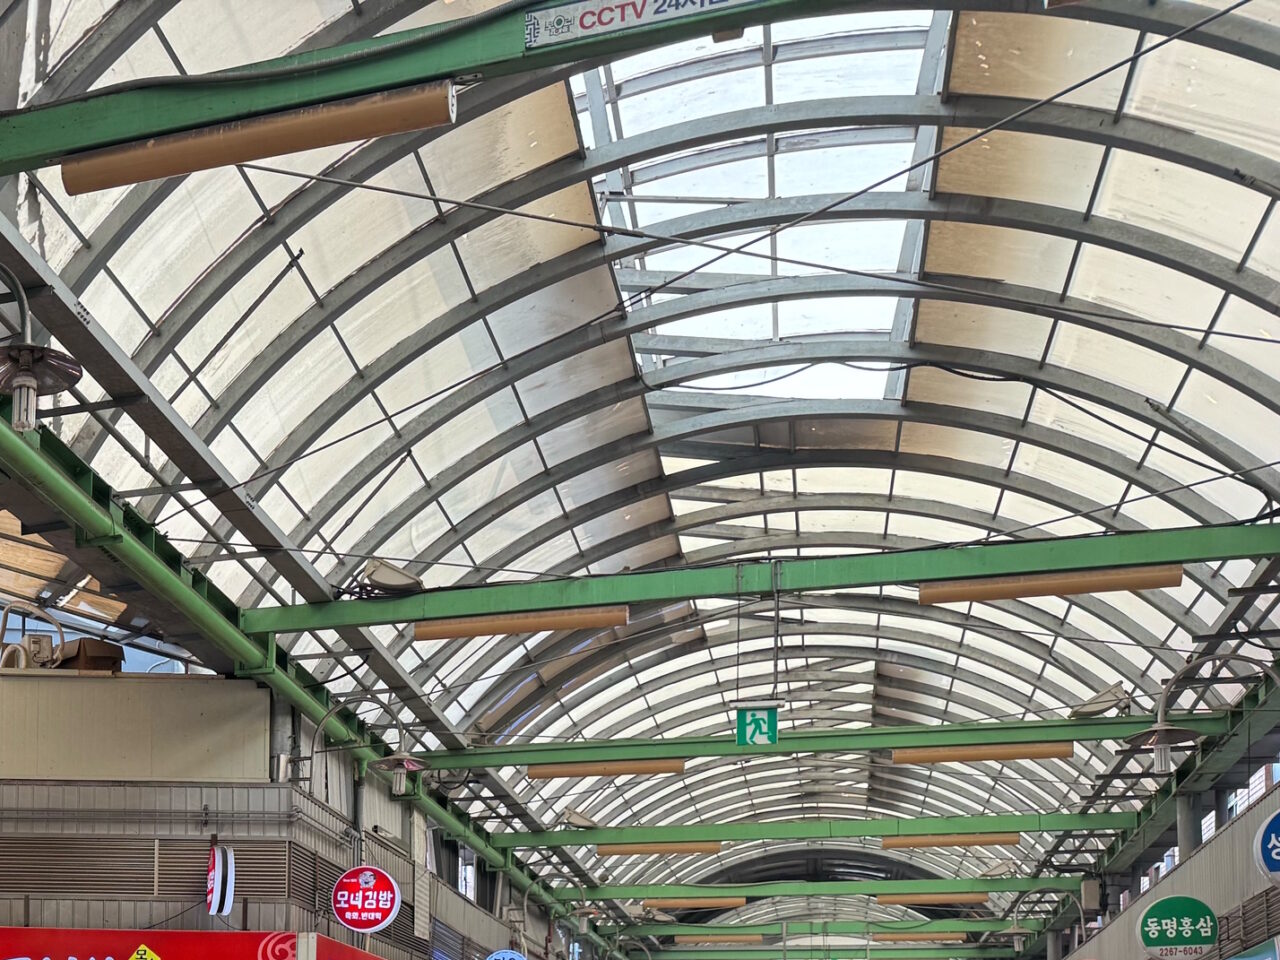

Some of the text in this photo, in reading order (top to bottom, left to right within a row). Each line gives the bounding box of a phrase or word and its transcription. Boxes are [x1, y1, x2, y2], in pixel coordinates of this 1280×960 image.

[578, 1, 648, 30] CCTV
[335, 890, 394, 910] 모녀김밥
[1143, 915, 1214, 939] 동명홍삼
